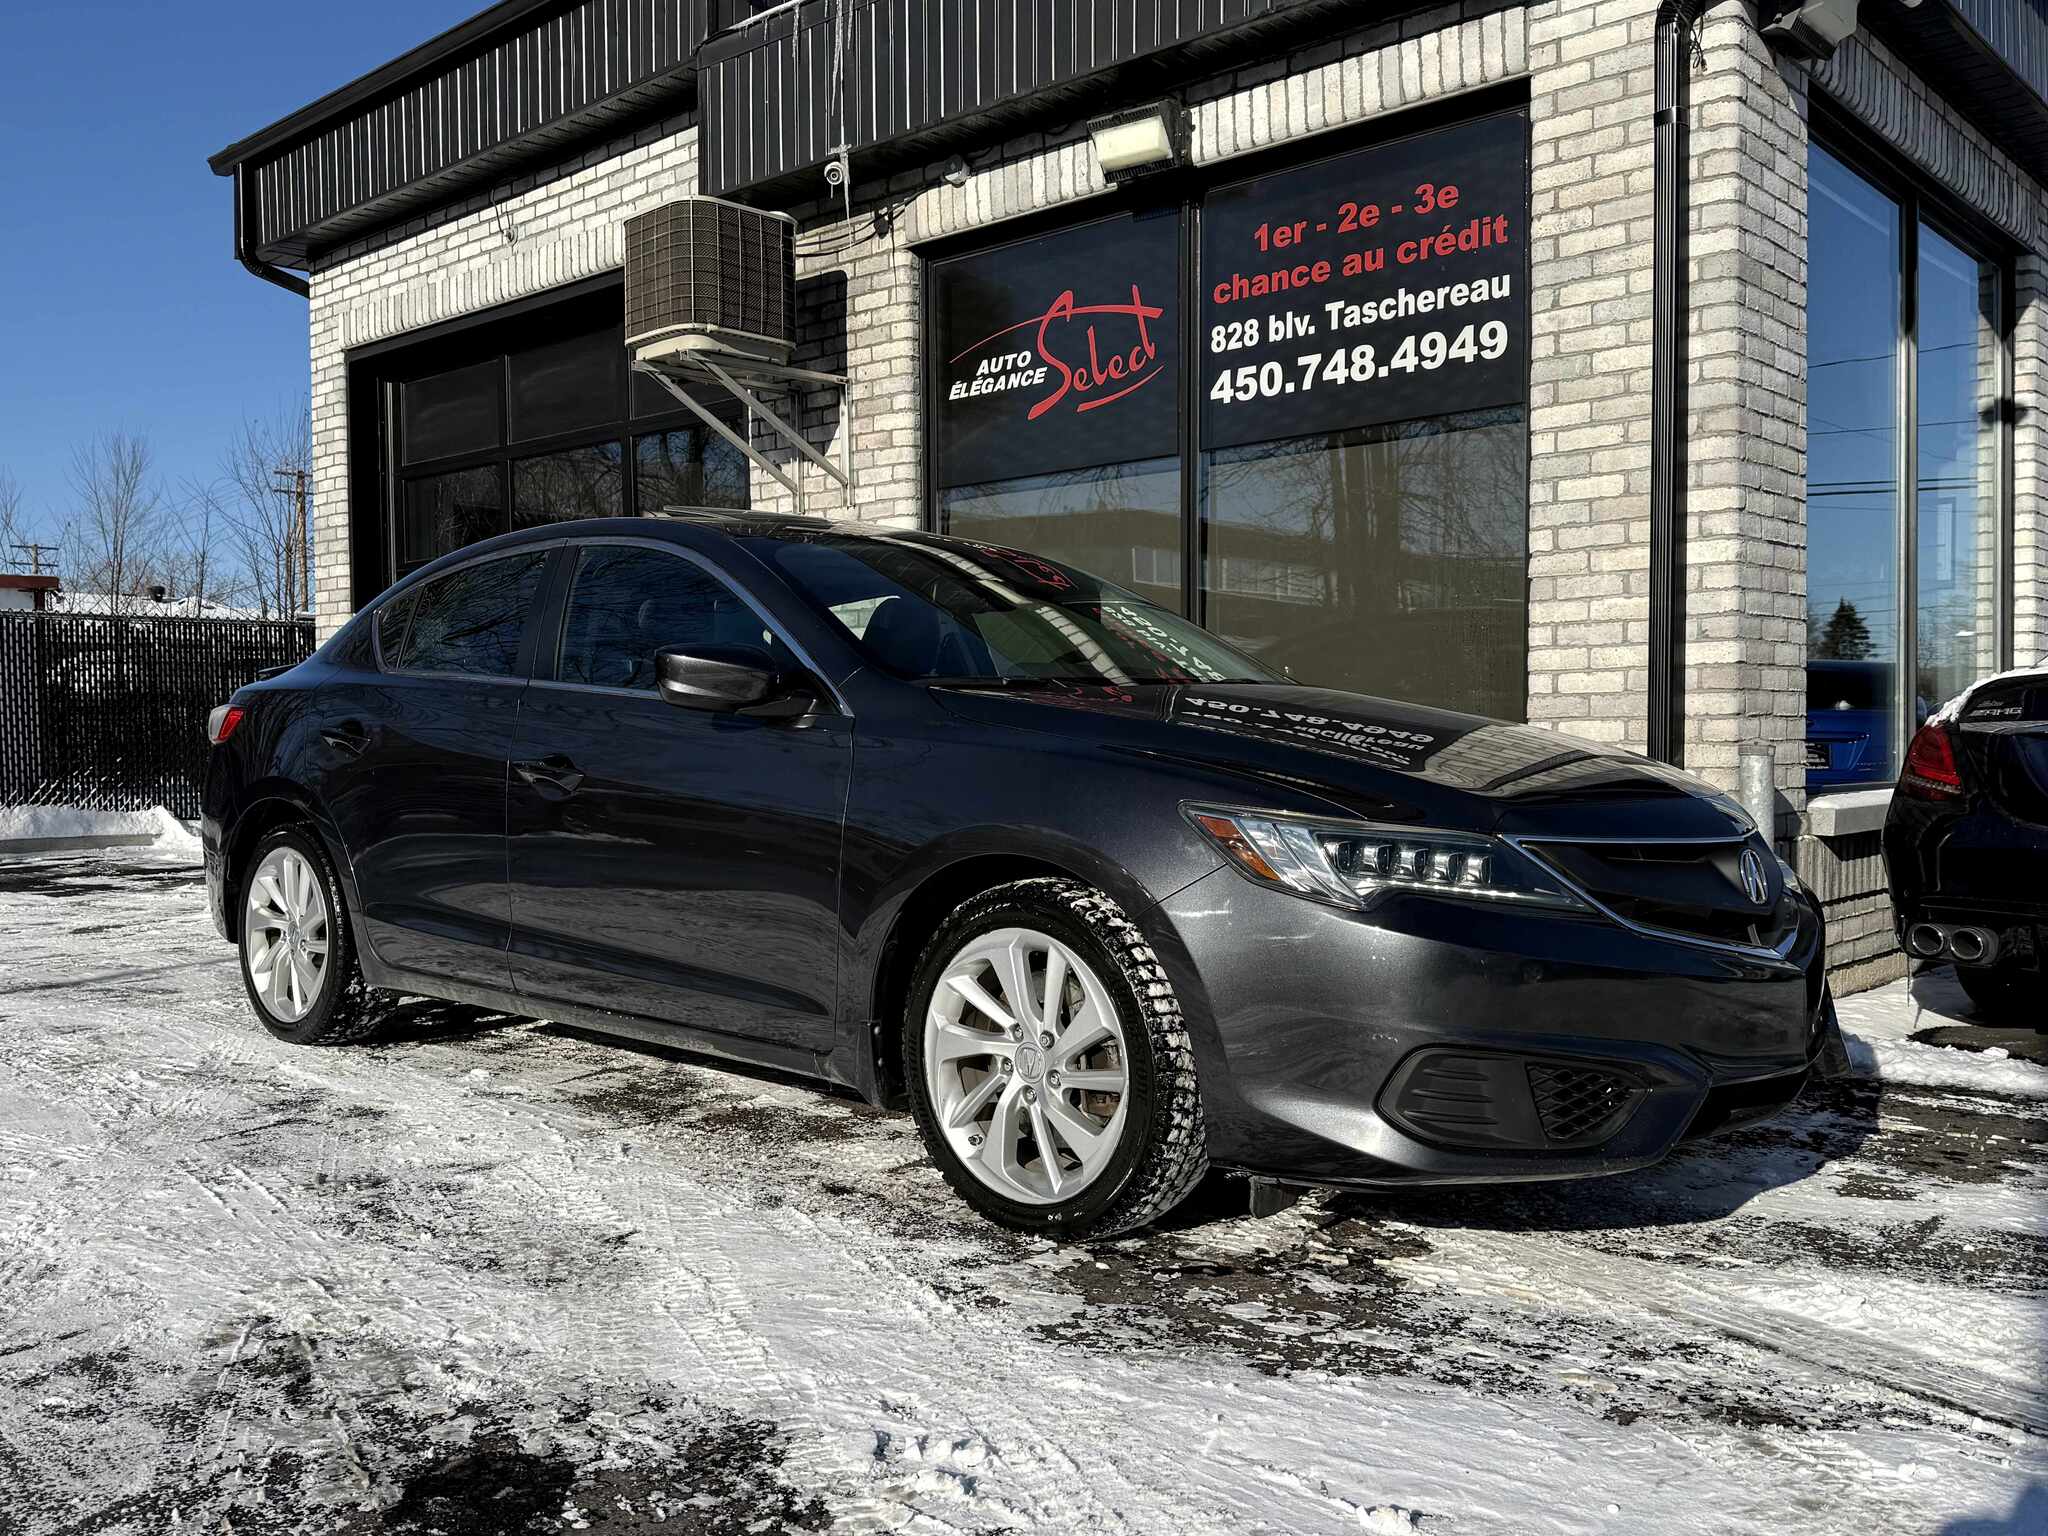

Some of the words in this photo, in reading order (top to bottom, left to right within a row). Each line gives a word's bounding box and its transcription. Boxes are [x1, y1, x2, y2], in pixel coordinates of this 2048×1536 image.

[1254, 221, 1307, 251] 1er
[1337, 202, 1379, 233] 2e
[1414, 183, 1459, 214] 3e
[1213, 260, 1331, 304] chance
[1342, 248, 1384, 277] au
[1396, 214, 1509, 264] crédit
[1211, 318, 1260, 353] 828
[1269, 311, 1316, 343] blv.
[1325, 274, 1511, 331] Taschereau
[949, 366, 1048, 401] ÉLÉGANCE
[976, 350, 1032, 377] AUTO
[1210, 320, 1509, 404] 450.748.4949
